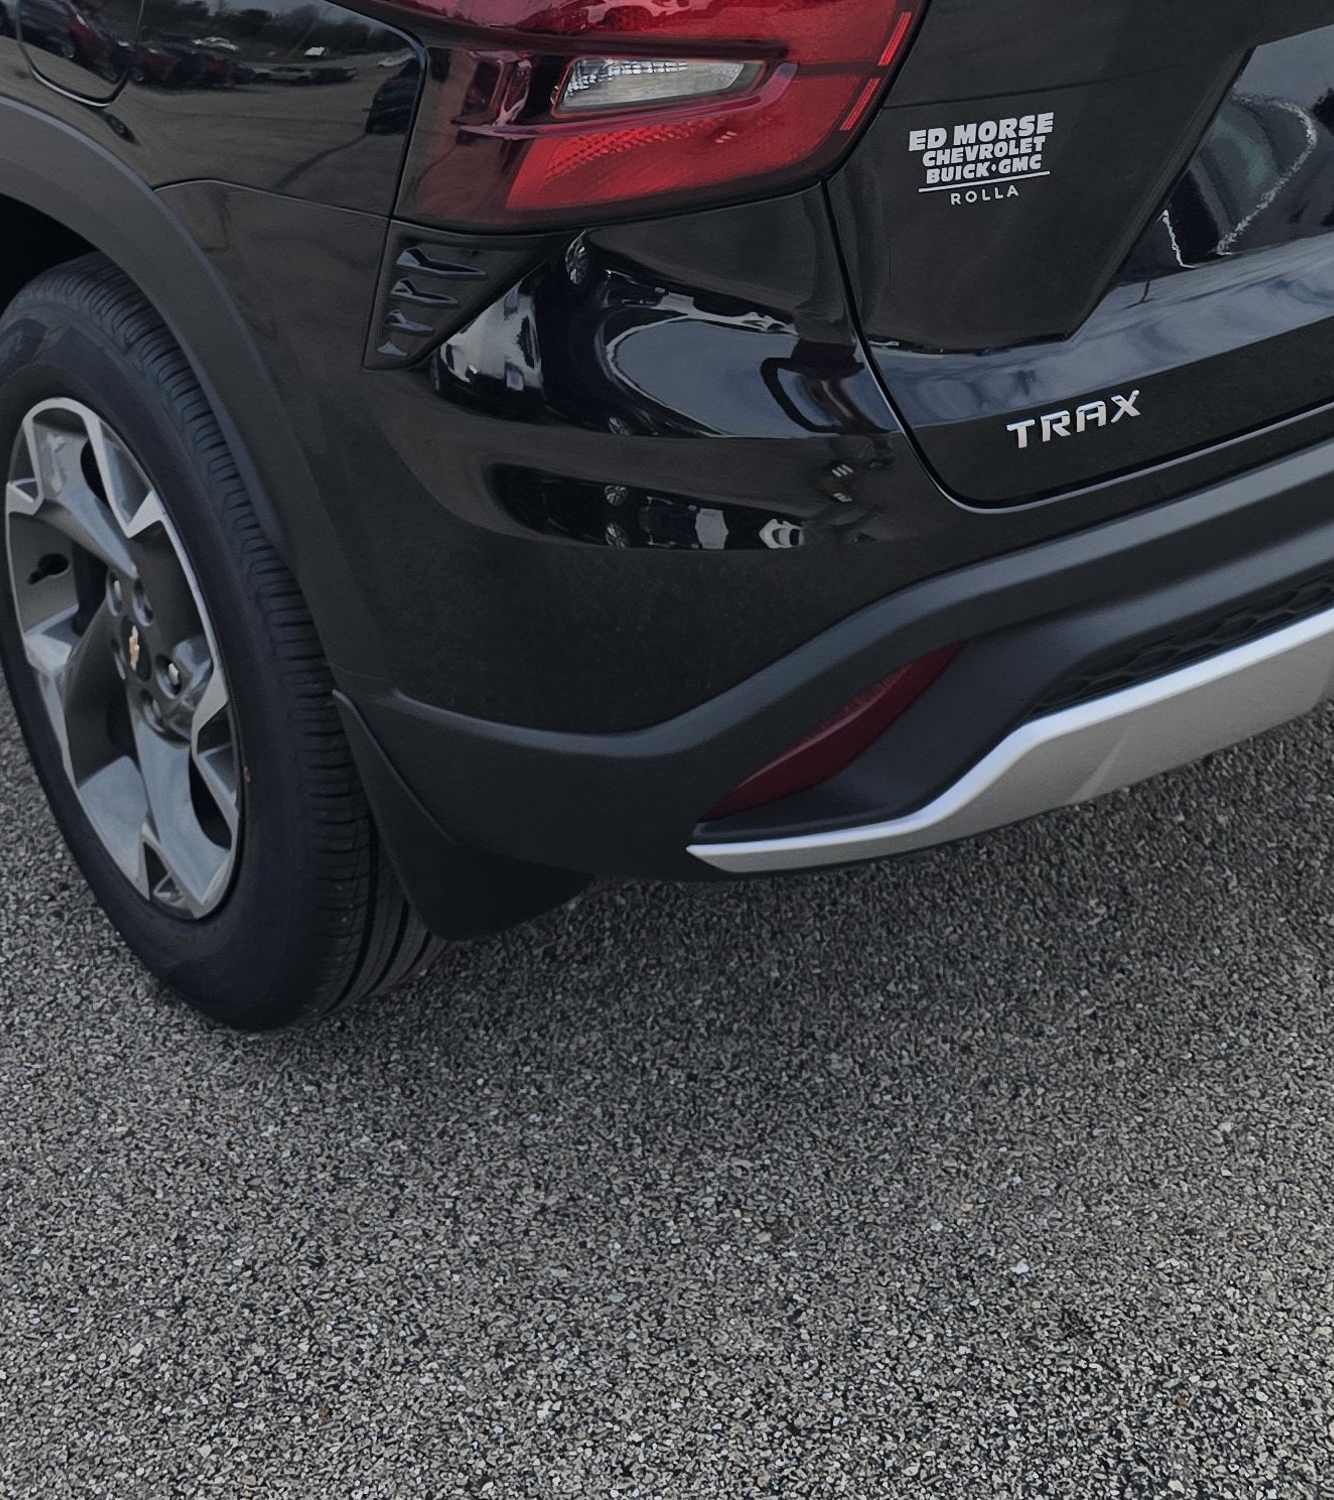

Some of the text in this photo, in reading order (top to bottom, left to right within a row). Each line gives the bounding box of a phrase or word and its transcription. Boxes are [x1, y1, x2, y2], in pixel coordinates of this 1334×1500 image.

[908, 111, 1055, 152] ED MORSE
[922, 135, 1046, 167] CHEVROLET
[950, 184, 1019, 205] ROLLA
[1006, 389, 1141, 449] TRAX
